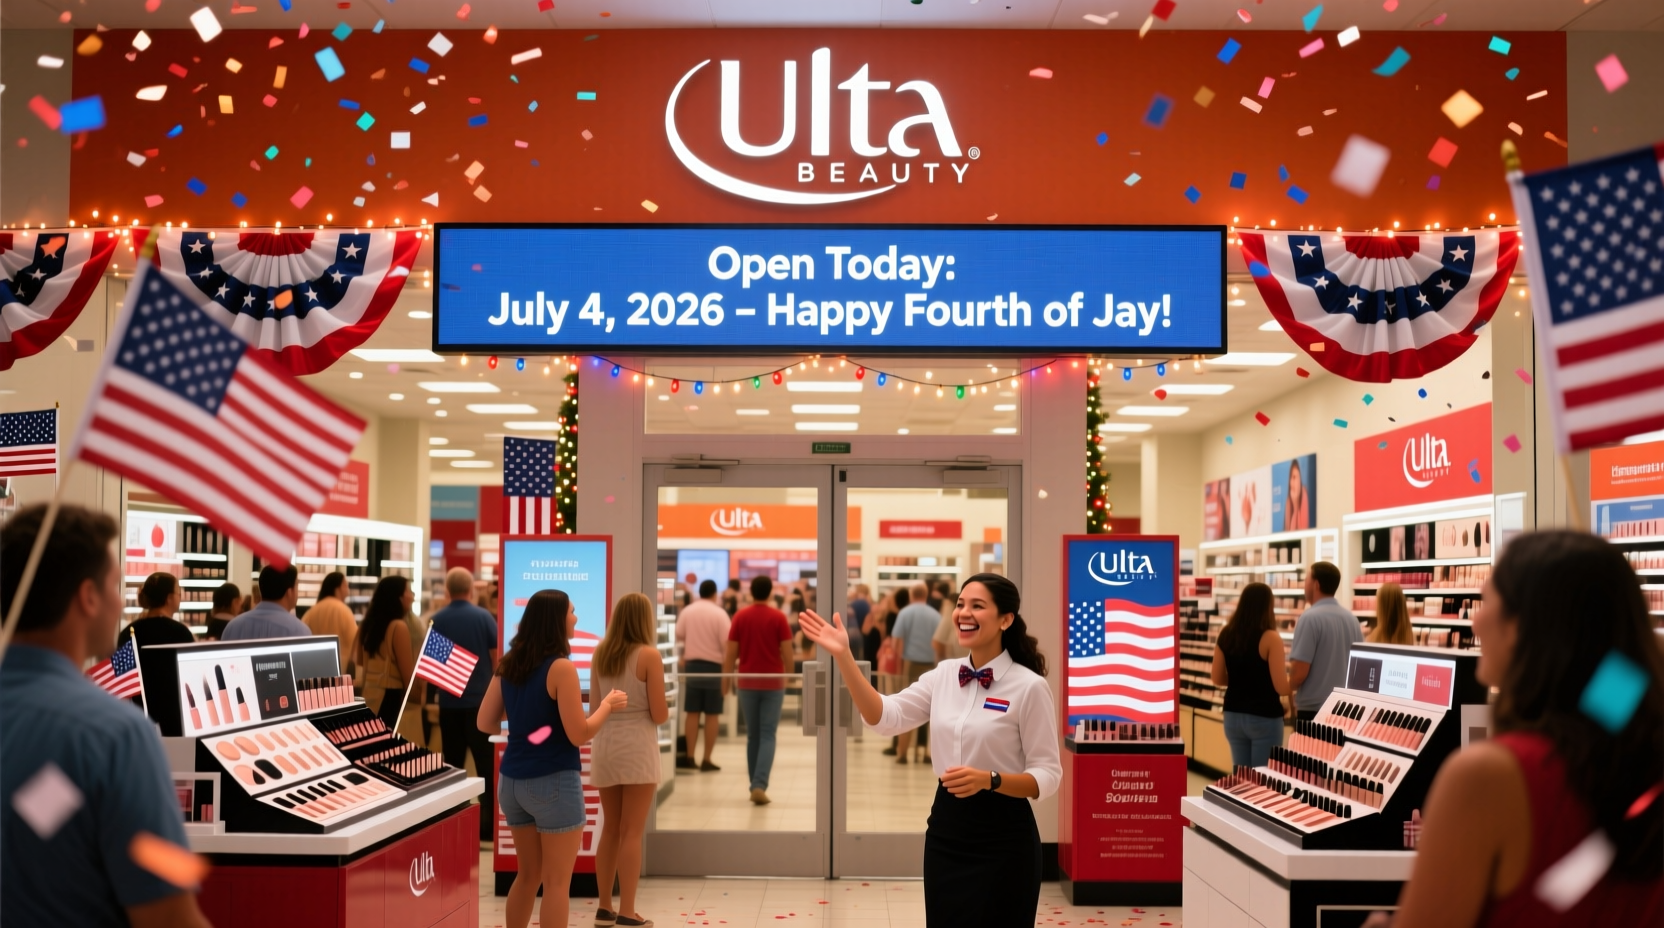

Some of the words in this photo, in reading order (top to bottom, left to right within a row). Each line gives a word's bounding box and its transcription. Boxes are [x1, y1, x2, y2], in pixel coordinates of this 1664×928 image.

[720, 47, 963, 157] Ulta
[797, 162, 969, 184] BEAUTY
[708, 245, 815, 289] Open
[826, 245, 956, 289] Today:
[487, 291, 570, 335] July
[578, 292, 616, 333] 4,
[626, 292, 725, 327] 2026
[767, 292, 894, 336] Happy
[904, 291, 1032, 327] Fourth
[1043, 291, 1085, 328] of
[1092, 293, 1171, 336] Jay!
